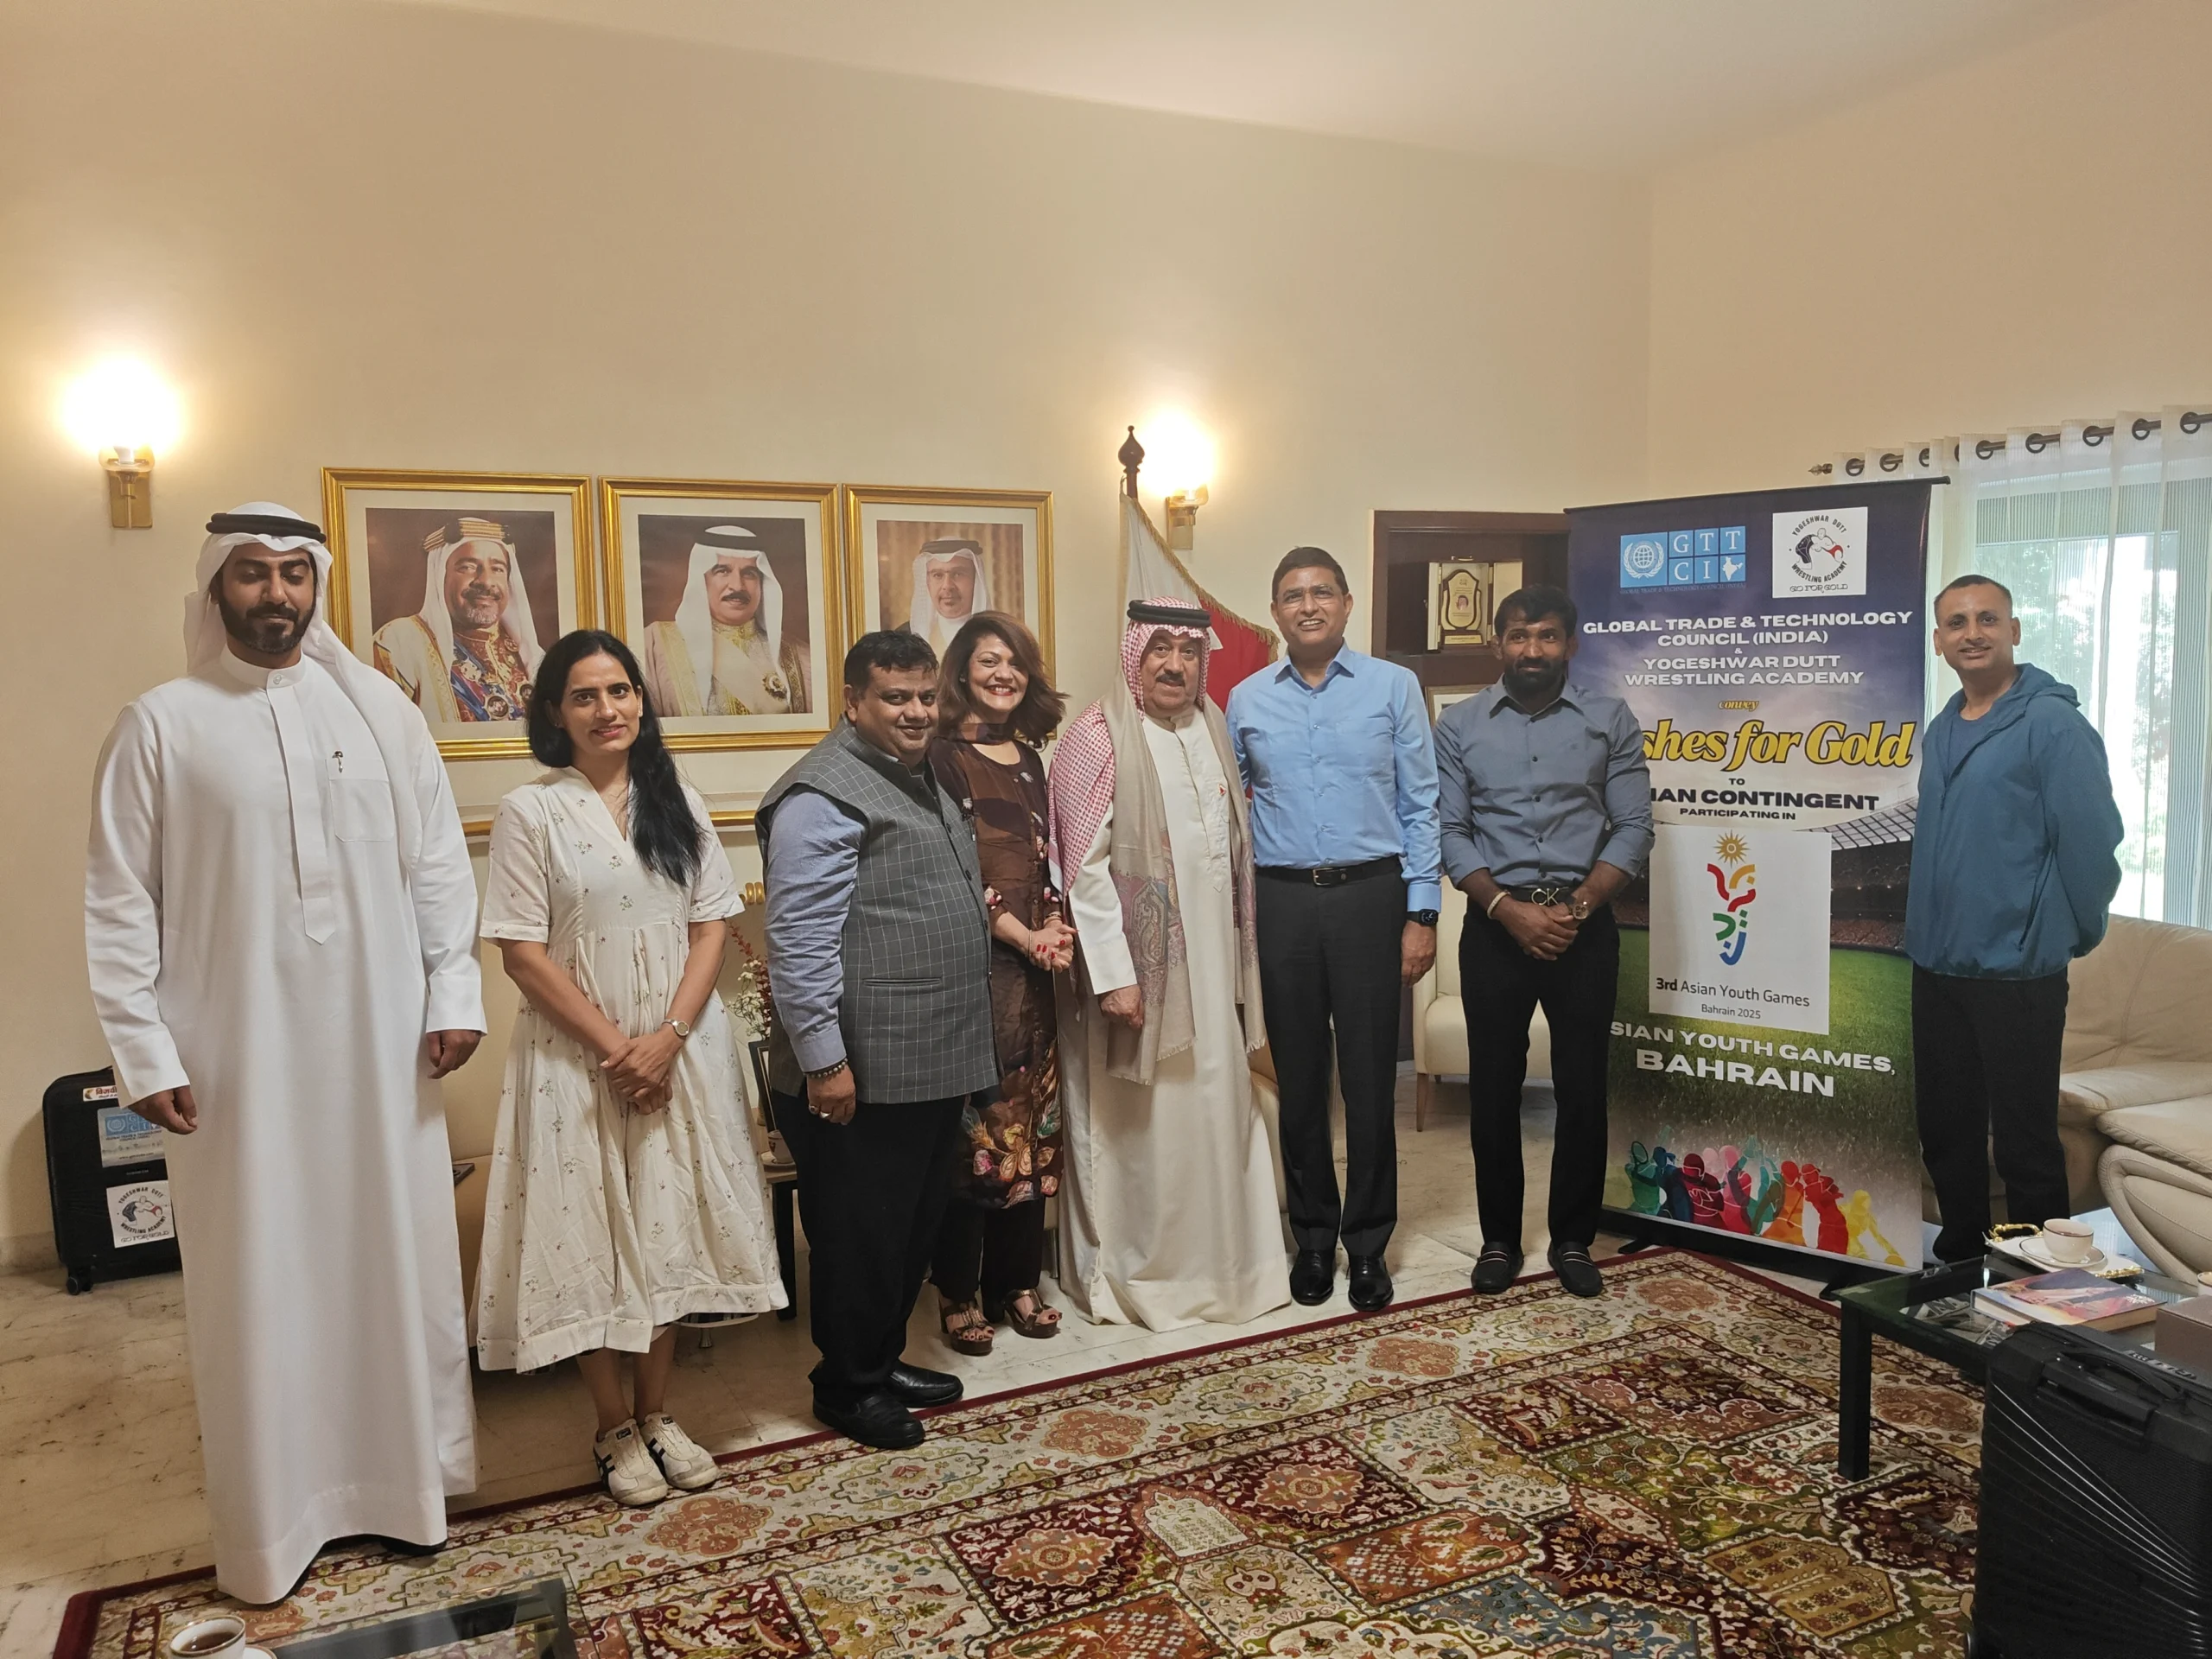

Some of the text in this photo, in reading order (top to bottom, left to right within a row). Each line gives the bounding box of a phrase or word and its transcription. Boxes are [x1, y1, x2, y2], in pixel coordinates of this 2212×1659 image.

[1791, 514, 1847, 536] YOGESHWAR DUTT
[1791, 560, 1847, 583] WRESTLING ACADEMY
[1804, 584, 1824, 594] FOR
[1583, 611, 1913, 634] GLOBAL TRADE & TECHNOLOGY
[1657, 630, 1828, 646] COUNCIL (INDIA)
[1643, 655, 1840, 671] YOGESHWAR DUTT
[1625, 671, 1864, 686] WRESTLING ACADEMY
[1718, 700, 1760, 712] convey
[1642, 718, 1917, 772] shes for Gold
[1650, 788, 1879, 810] IAN CONTINGENT
[1680, 808, 1796, 820] PARTICIPATING IN
[1531, 887, 1560, 906] CK
[1656, 977, 1810, 1007] 3rd Asian Youth Games
[1701, 1003, 1761, 1020] Bahrain 2025
[1610, 1020, 1896, 1075] SIAN YOUTH GAMES,
[1637, 1048, 1834, 1097] BAHRAIN
